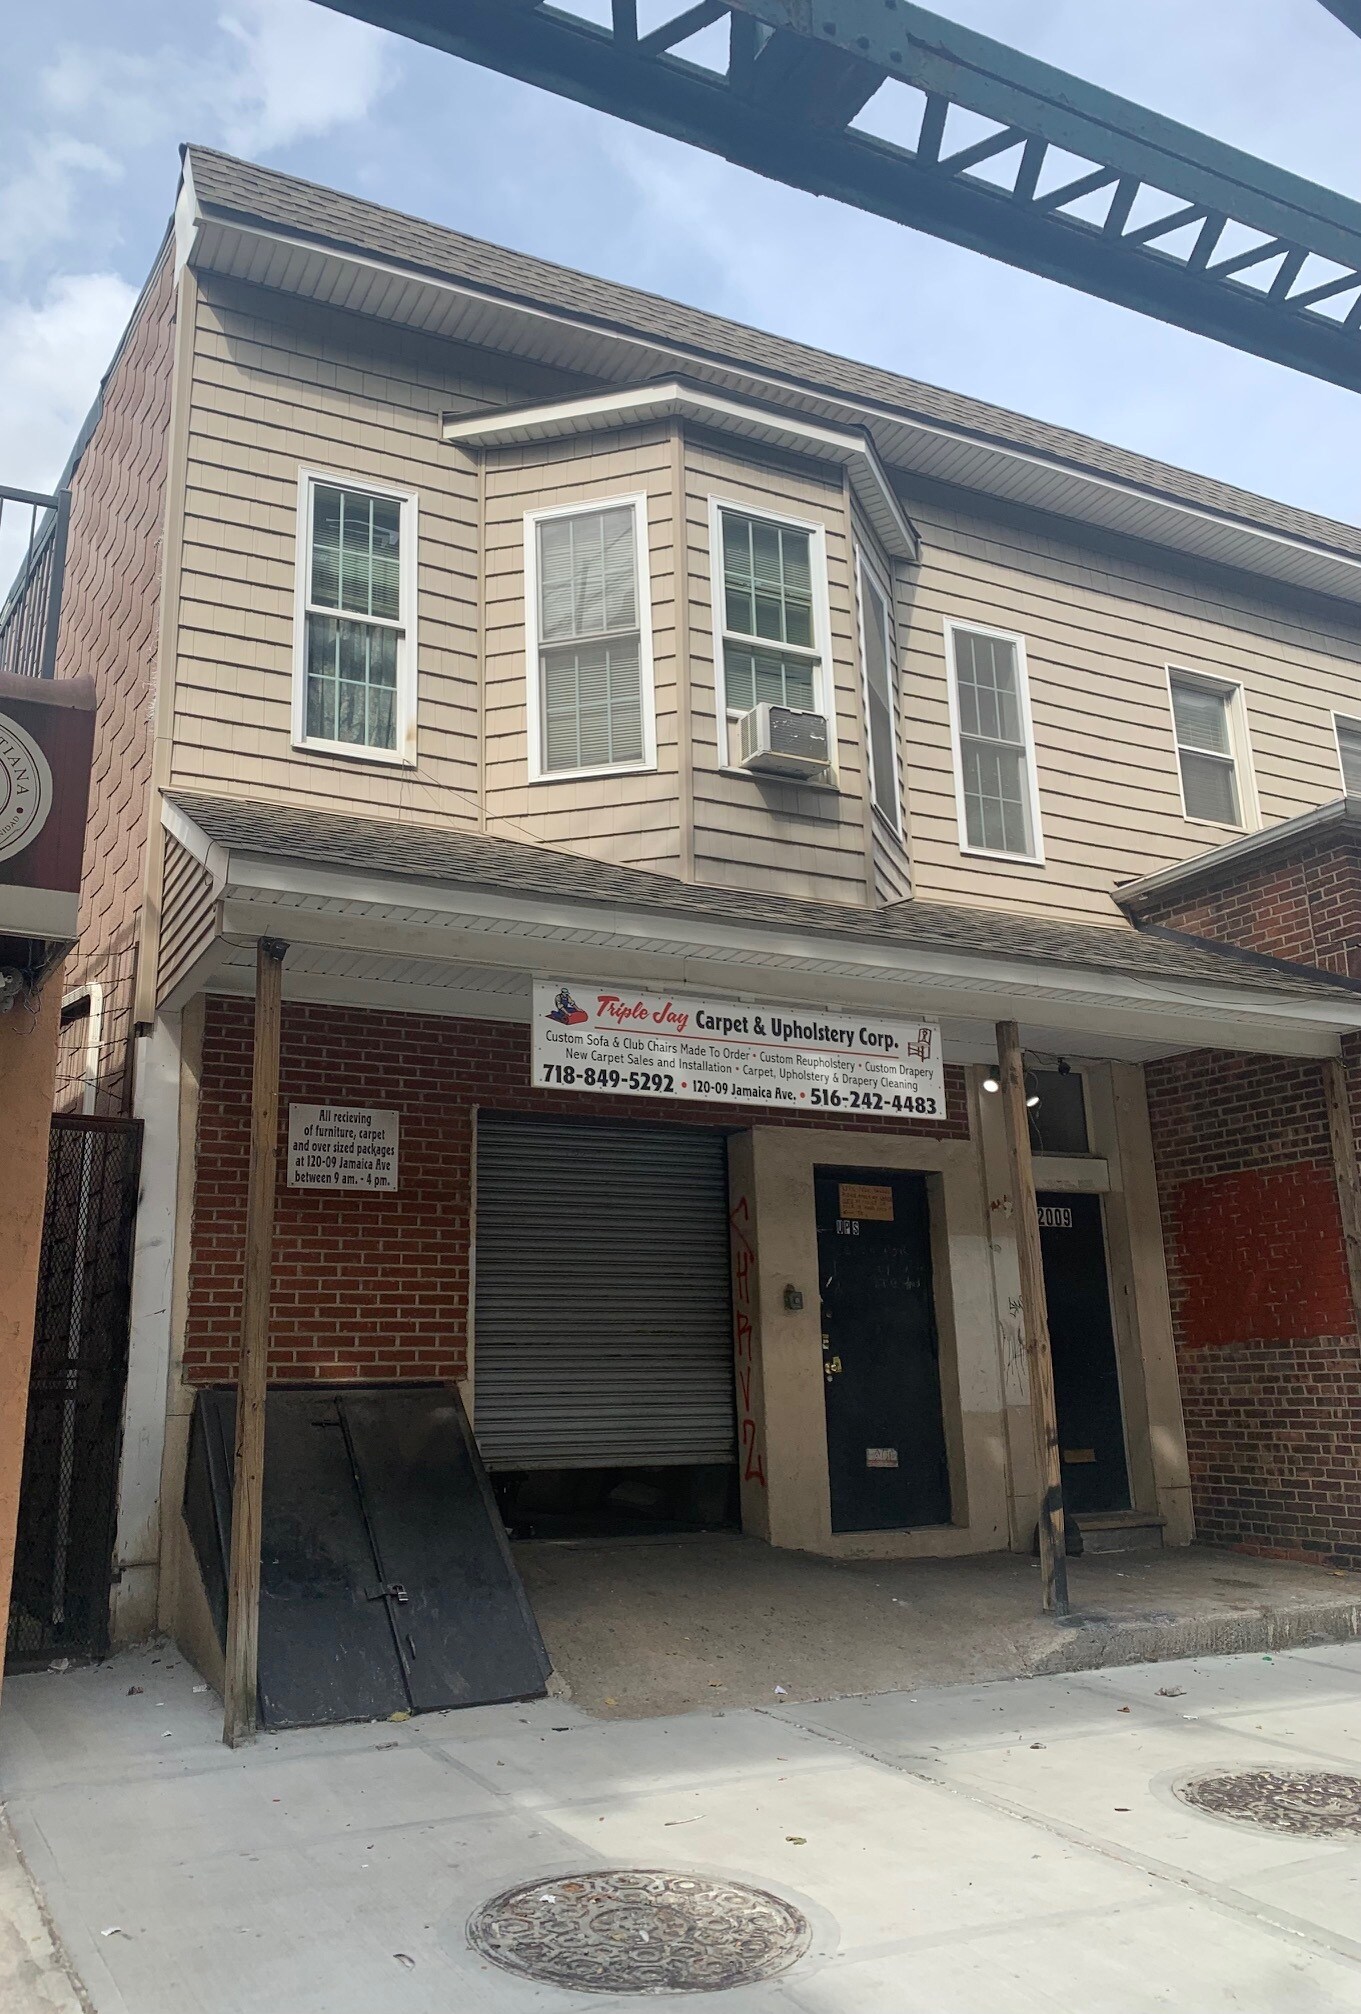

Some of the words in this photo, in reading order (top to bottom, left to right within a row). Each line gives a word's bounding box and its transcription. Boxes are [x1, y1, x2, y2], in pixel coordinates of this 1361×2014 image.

[596, 995, 649, 1024] Triple
[653, 1002, 689, 1033] Jay
[696, 1010, 749, 1036] Carpet
[753, 1016, 767, 1036] &
[771, 1018, 854, 1048] Upholstery
[859, 1027, 899, 1051] Corp.
[545, 1030, 584, 1045] Custom
[587, 1034, 609, 1047] Sofa
[612, 1036, 620, 1048] &
[623, 1038, 645, 1051] Club
[647, 1040, 678, 1053] Chairs
[680, 1043, 706, 1056] Made
[709, 1046, 720, 1058] To
[723, 1047, 750, 1060] Order
[760, 1051, 793, 1065] Custom
[796, 1054, 856, 1072] Reupholstery
[865, 1061, 897, 1074] Custom
[899, 1064, 934, 1080] Drapery
[565, 1048, 588, 1060] New
[591, 1050, 624, 1065] Carpet
[627, 1053, 654, 1067] Sales
[657, 1058, 675, 1068] and
[679, 1059, 732, 1073] Installation
[742, 1064, 776, 1079] Carpet,
[779, 1067, 830, 1084] Upholstery
[832, 1073, 839, 1083] &
[842, 1073, 878, 1089] Drapery
[880, 1077, 918, 1092] Cleaning
[543, 1063, 674, 1093] 718-849-5292
[693, 1080, 728, 1094] 120-09
[731, 1083, 772, 1099] Jamaica
[774, 1087, 797, 1101] Ave.
[810, 1088, 937, 1115] 516-242-4483
[319, 1109, 331, 1122] All
[333, 1111, 372, 1126] recieving
[304, 1124, 314, 1136] of
[315, 1124, 357, 1140] furniture,
[359, 1129, 385, 1142] carpet
[292, 1140, 310, 1152] and
[312, 1142, 331, 1152] over
[333, 1141, 355, 1154] sized
[357, 1143, 395, 1158] packages
[295, 1156, 305, 1167] at
[307, 1155, 337, 1168] 120-09
[339, 1157, 373, 1170] Jamaica
[375, 1158, 391, 1171] Ave
[295, 1170, 332, 1184] between
[333, 1171, 339, 1184] 9
[341, 1174, 358, 1185] am.
[366, 1173, 372, 1186] 4
[374, 1176, 390, 1188] pm.
[1037, 1207, 1071, 1226] 2009
